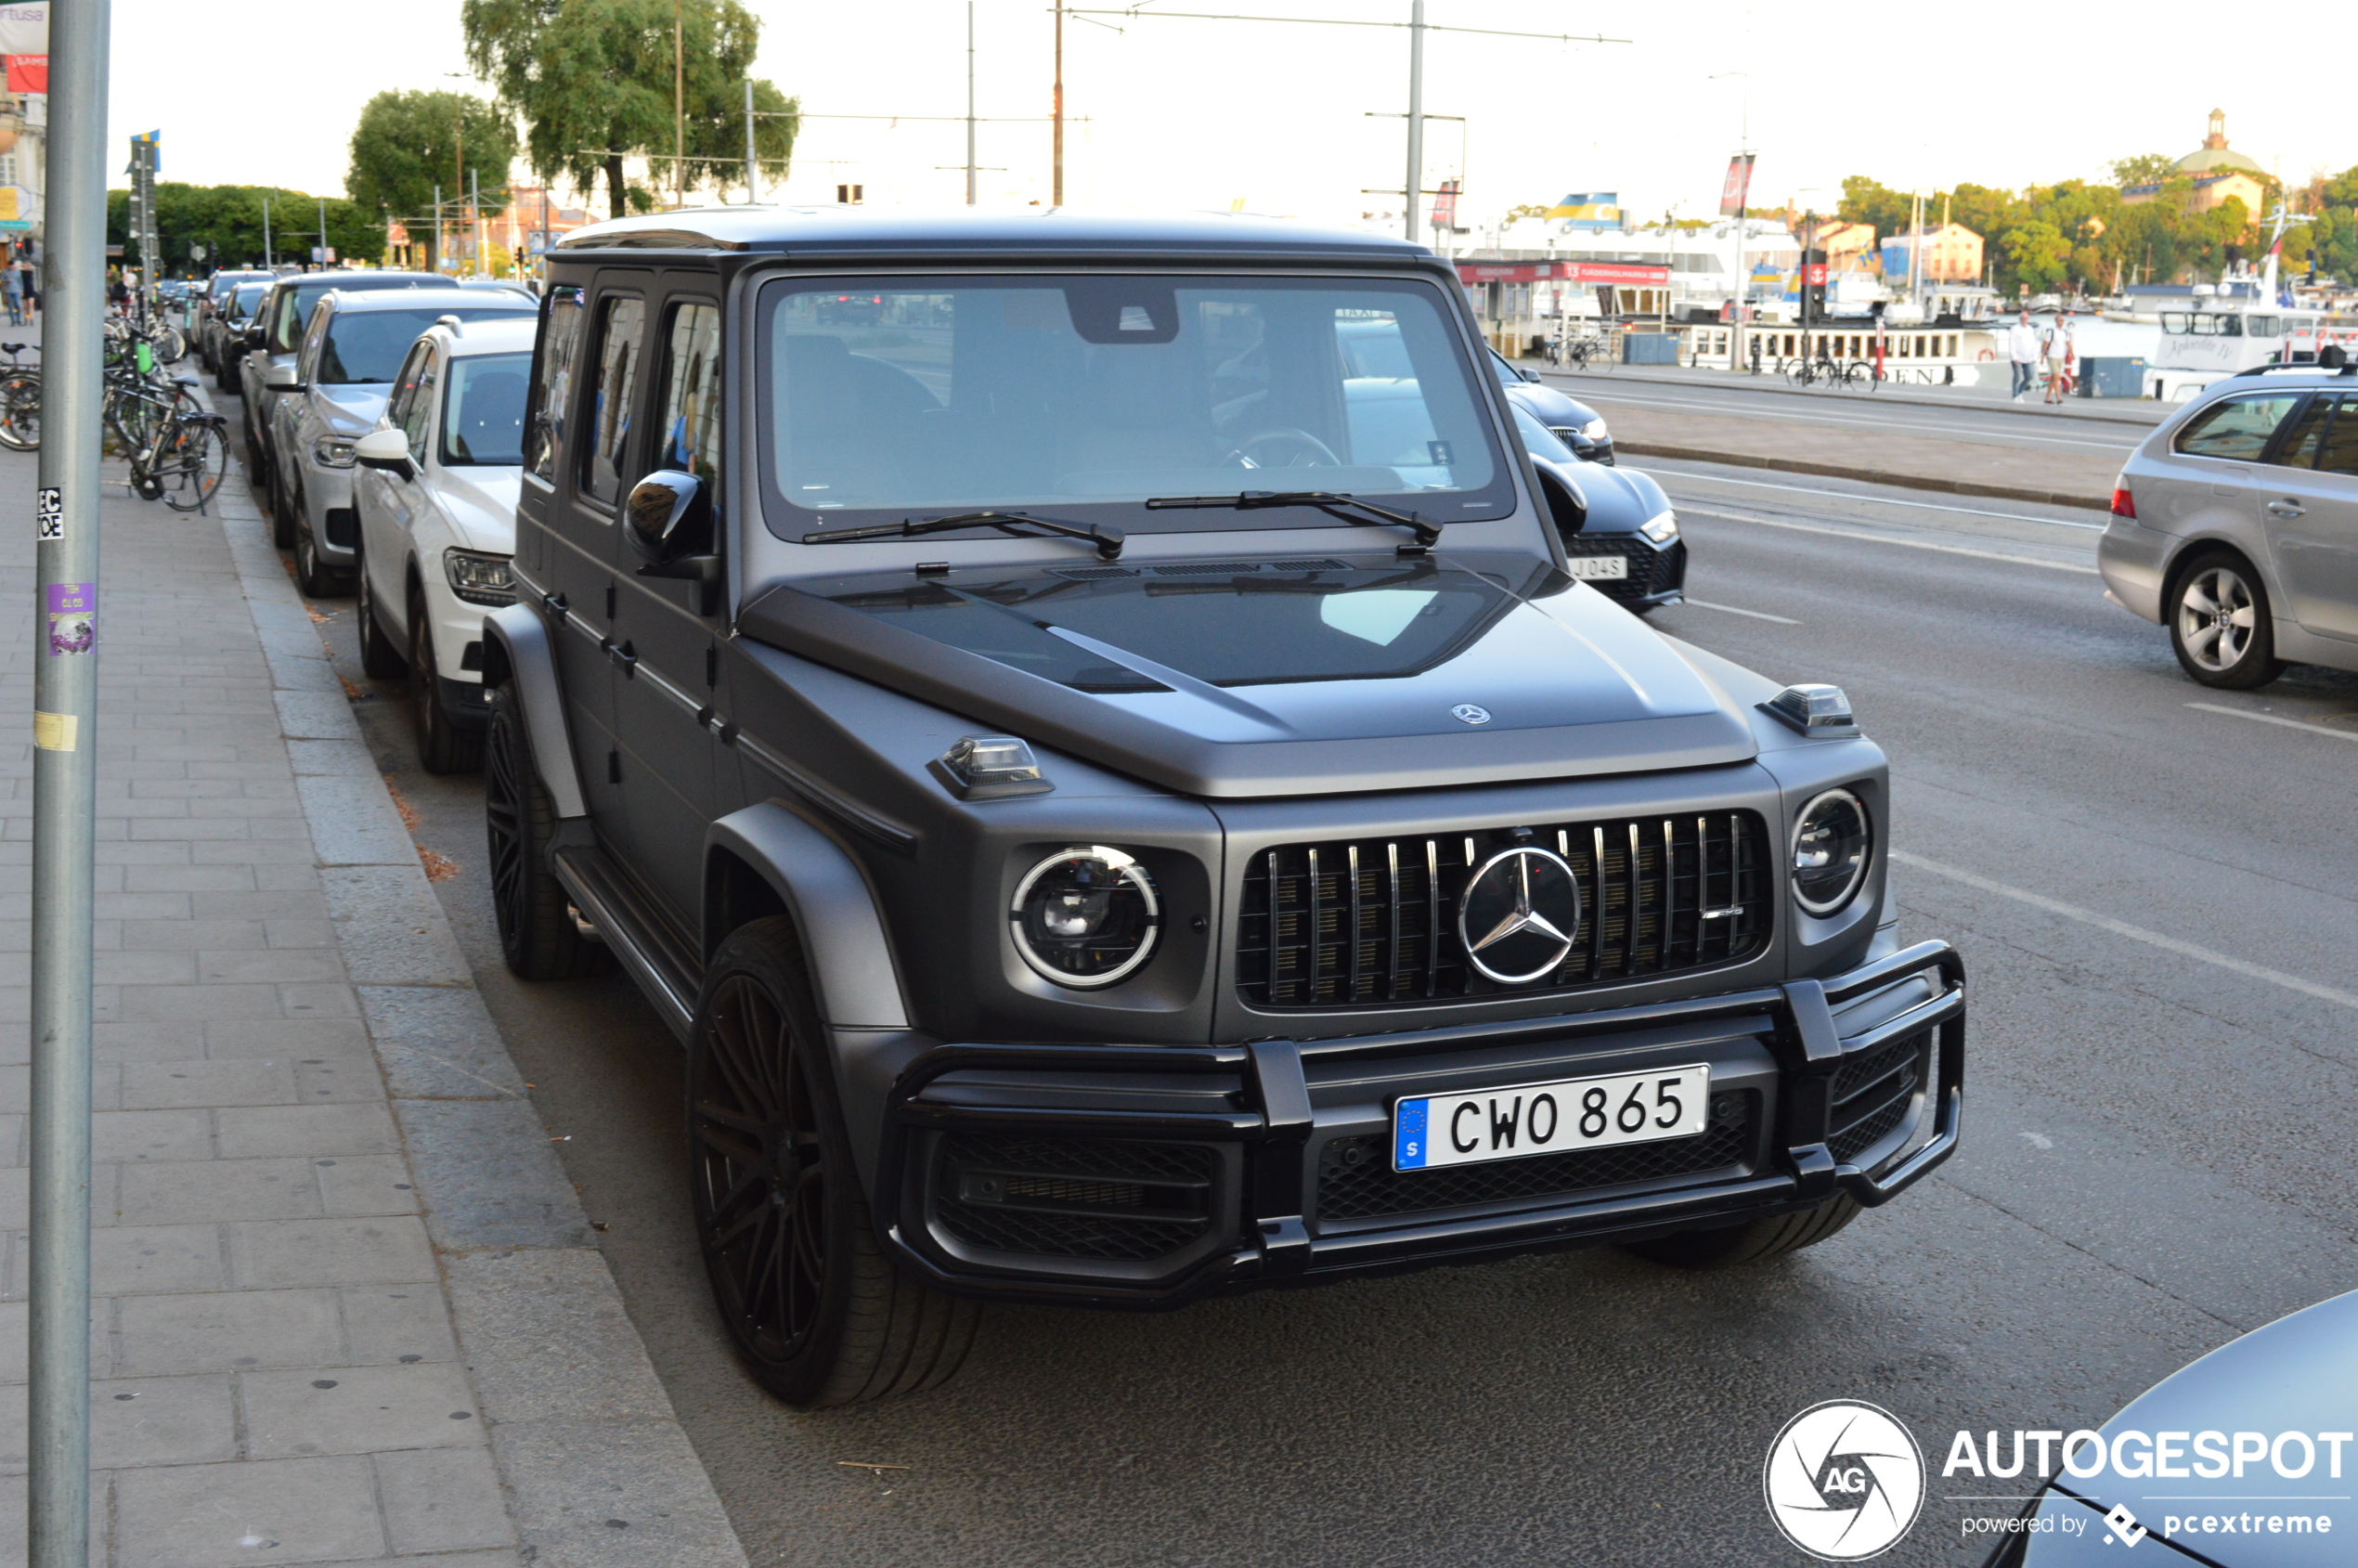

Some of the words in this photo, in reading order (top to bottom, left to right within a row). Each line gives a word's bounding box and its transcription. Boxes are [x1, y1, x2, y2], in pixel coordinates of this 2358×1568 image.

[1566, 266, 1579, 278] 13
[1450, 1091, 1558, 1154] CWO
[1579, 1077, 1683, 1139] 865
[1406, 1141, 1419, 1157] S
